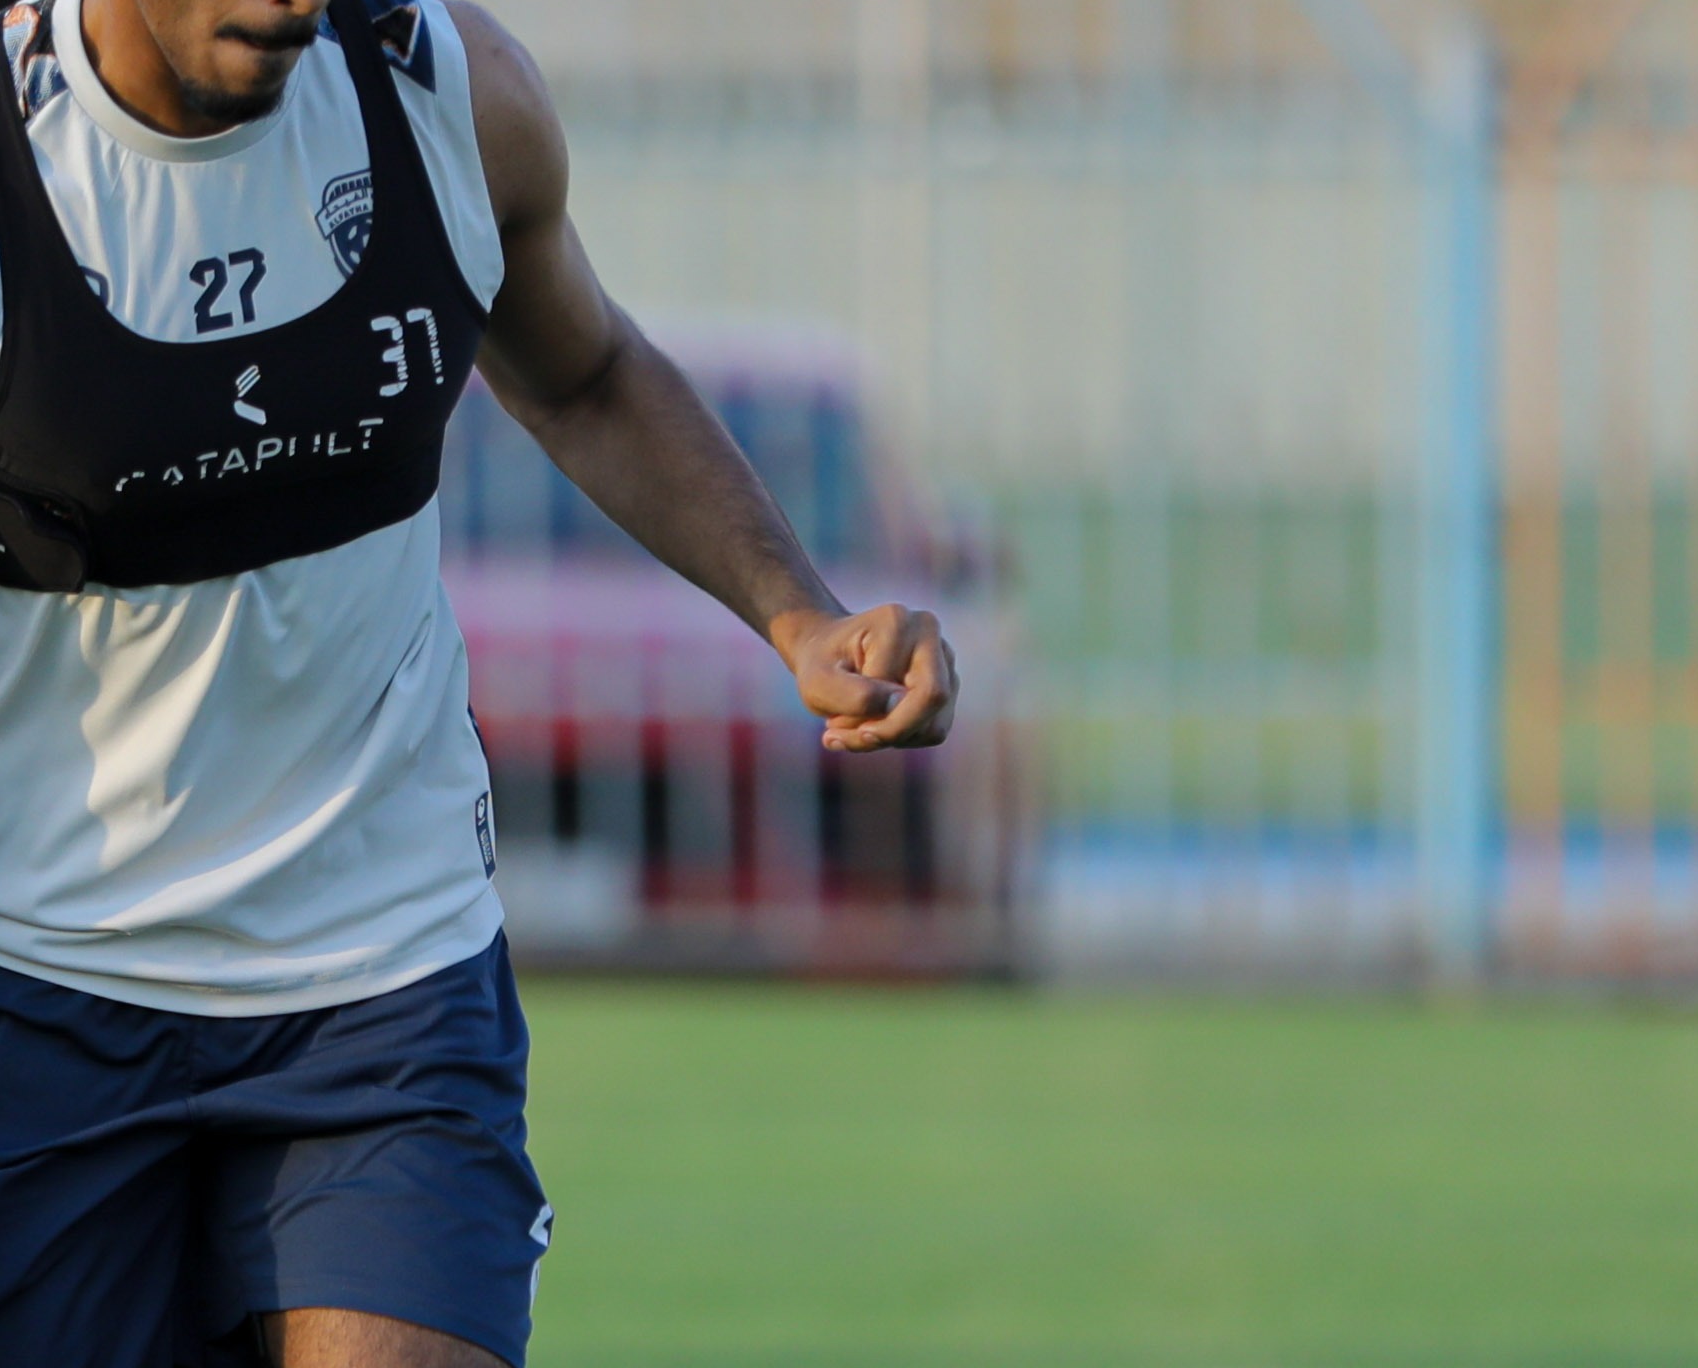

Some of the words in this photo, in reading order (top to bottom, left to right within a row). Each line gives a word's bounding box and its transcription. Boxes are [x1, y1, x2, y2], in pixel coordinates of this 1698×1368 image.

[328, 203, 369, 229] ALFAYHA
[190, 247, 267, 334] 27
[370, 307, 444, 397] 37
